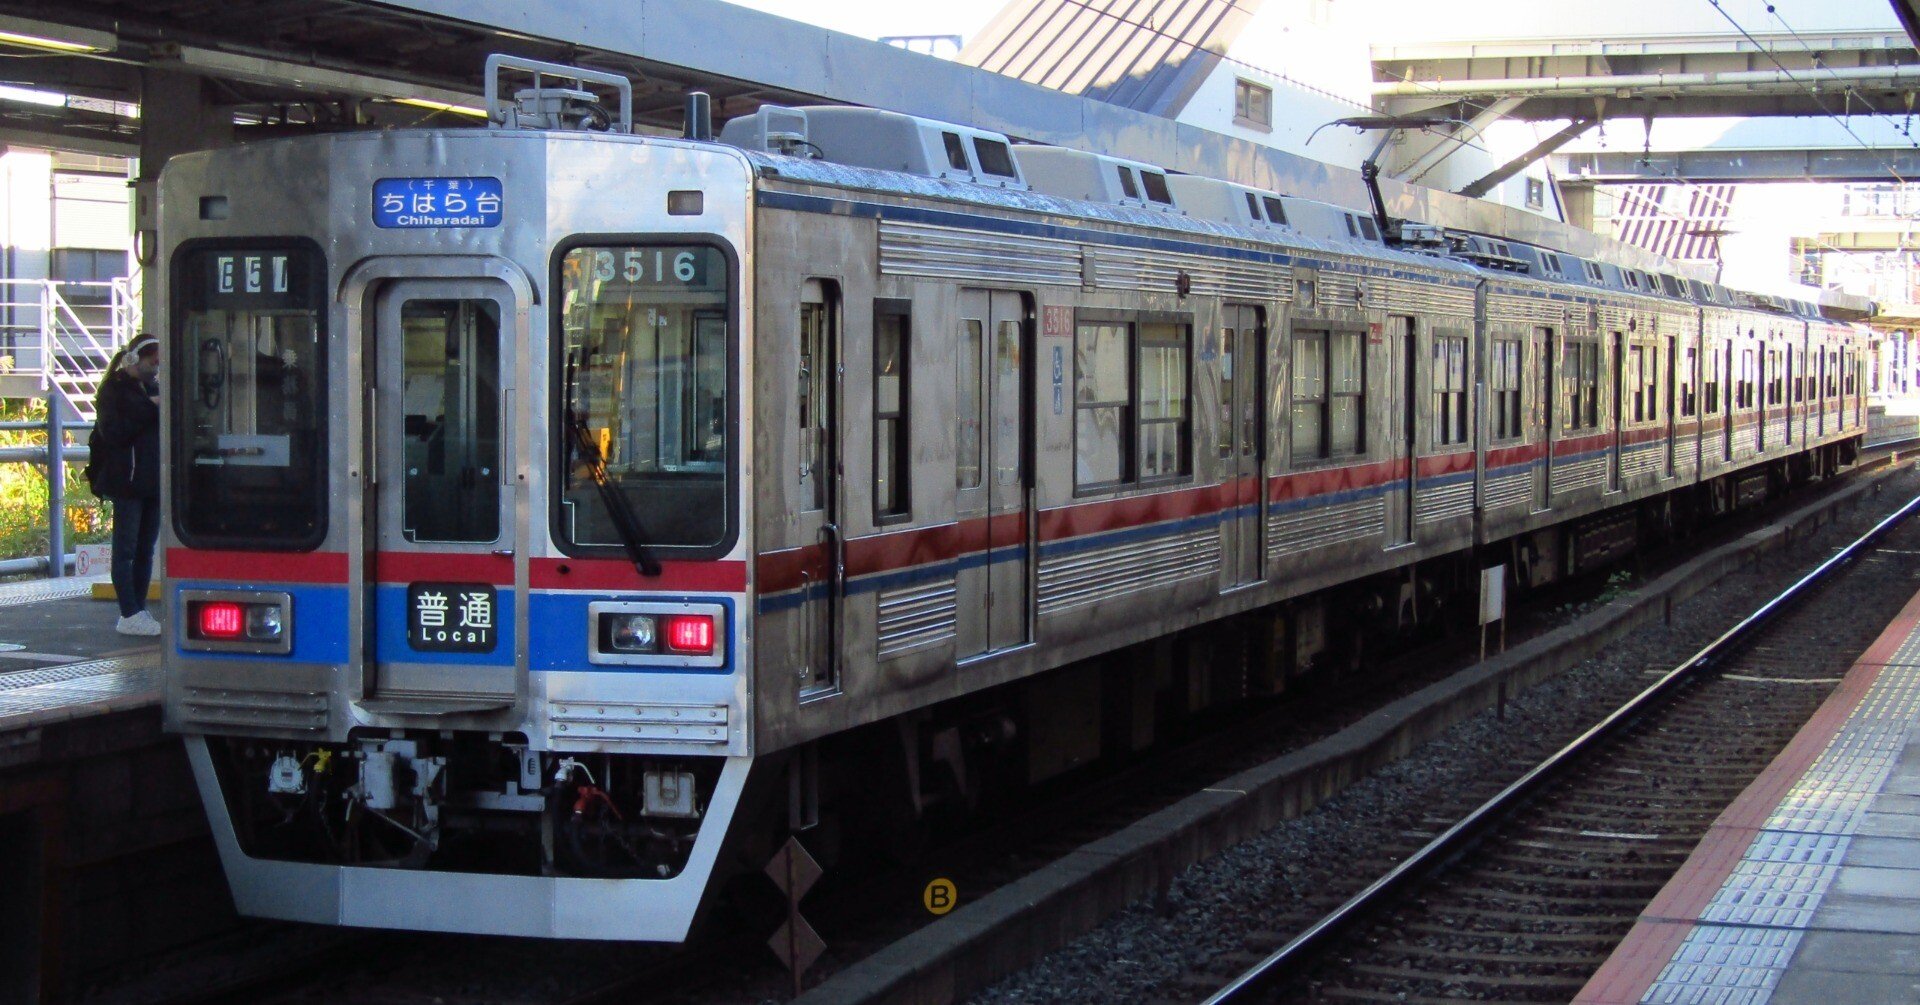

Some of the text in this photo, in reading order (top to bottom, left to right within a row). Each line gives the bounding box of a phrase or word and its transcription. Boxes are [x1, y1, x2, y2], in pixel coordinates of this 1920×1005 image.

[382, 191, 501, 213] ちはら台
[396, 215, 485, 226] Chiharadai
[595, 250, 695, 282] 3516
[1046, 308, 1070, 333] 3516
[417, 591, 491, 628] 普通
[422, 627, 486, 643] Local
[931, 885, 950, 908] B
